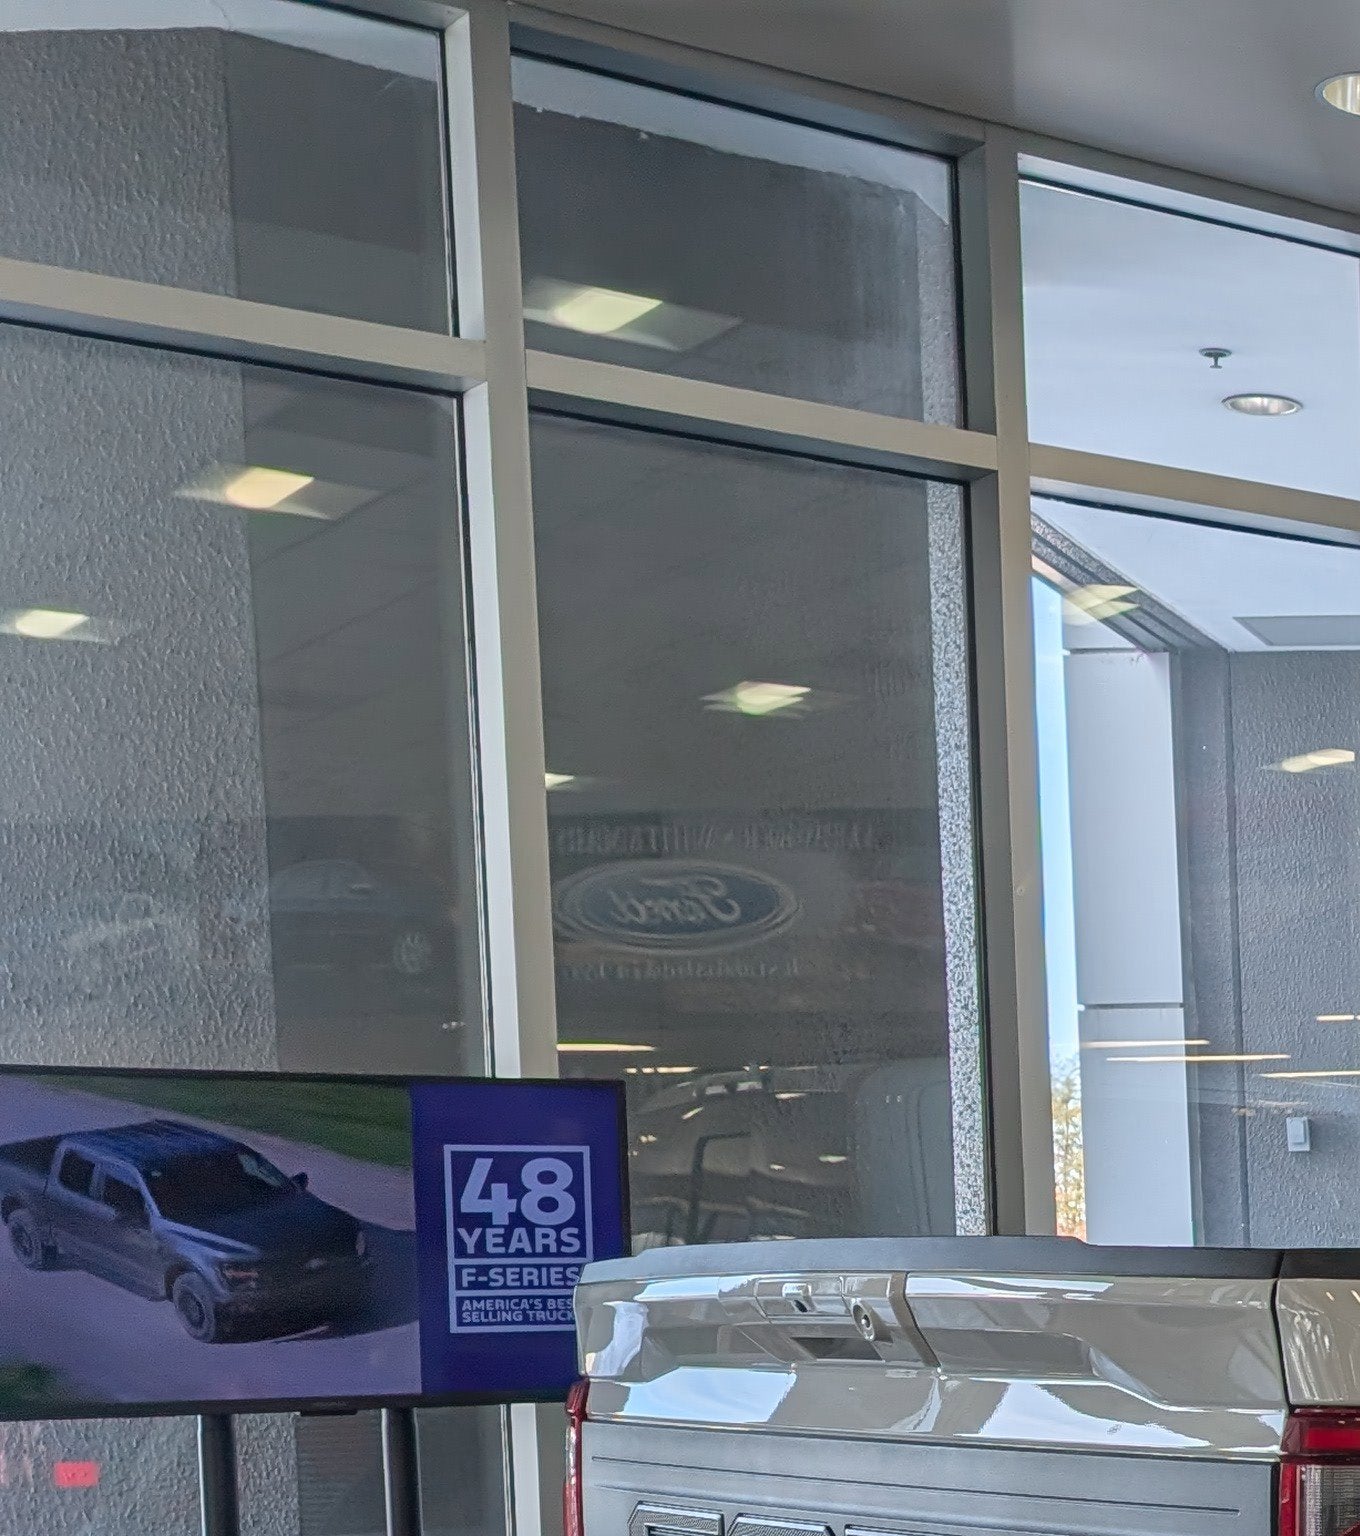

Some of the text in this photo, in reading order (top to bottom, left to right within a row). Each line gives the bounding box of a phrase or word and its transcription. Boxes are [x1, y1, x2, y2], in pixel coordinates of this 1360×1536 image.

[460, 1157, 576, 1226] 48
[457, 1226, 581, 1254] YEARS
[461, 1266, 580, 1288] F-SERIES
[462, 1298, 573, 1311] AMERICA'S BES
[462, 1310, 523, 1323] SELLING
